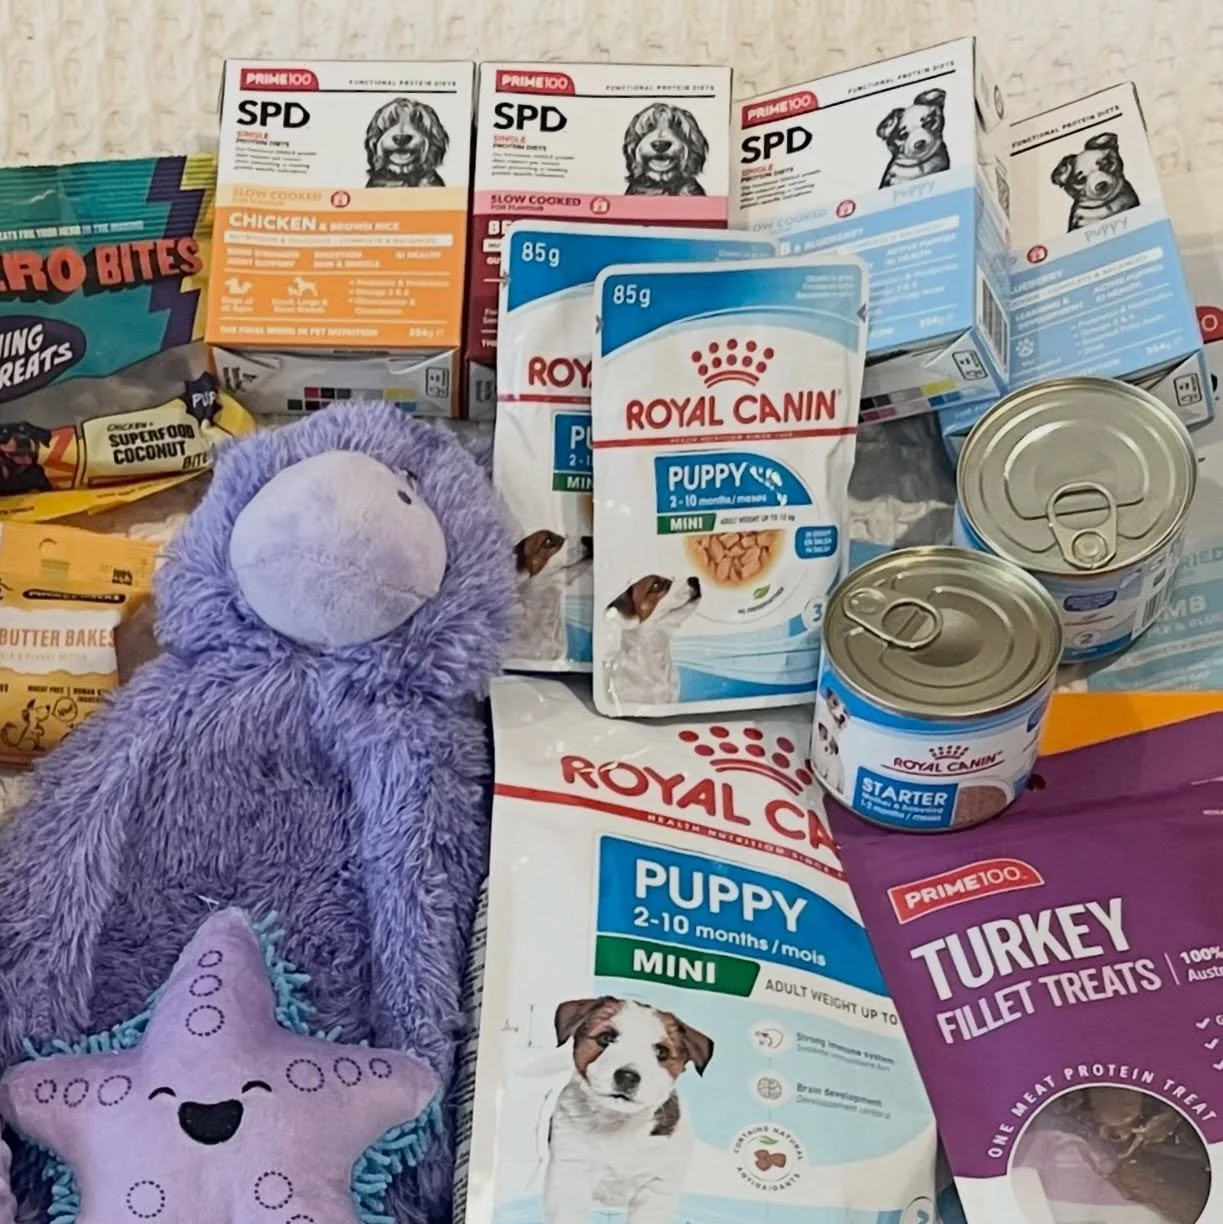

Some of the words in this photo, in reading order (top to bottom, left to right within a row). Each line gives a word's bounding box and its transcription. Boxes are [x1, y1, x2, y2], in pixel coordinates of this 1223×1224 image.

[246, 73, 312, 87] PRIME100
[501, 75, 568, 90] PRIME100
[237, 100, 311, 129] SPD
[493, 102, 567, 132] SPD
[747, 97, 812, 120] PRIME100
[740, 126, 813, 164] SPD
[491, 194, 526, 205] SLOW
[528, 195, 582, 207] COOKED
[229, 212, 317, 231] CHICKEN
[95, 237, 205, 287] BITES
[626, 395, 724, 431] ROYAL
[732, 390, 837, 425] CANIN
[108, 423, 196, 448] SUPERFOOD
[113, 440, 187, 465] COCONUT
[668, 462, 749, 492] PUPPY
[669, 518, 703, 532] MINI
[812, 603, 824, 622] 3
[893, 756, 943, 773] ROYAL
[947, 753, 997, 771] CANIN
[561, 754, 751, 826] ROYAL
[861, 777, 949, 806] STARTER
[635, 858, 809, 934] PUPPY
[905, 866, 1022, 910] PRIME100
[633, 906, 690, 936] 2-10
[695, 923, 770, 952] months
[780, 943, 828, 969] mois
[910, 897, 1131, 1001] TURKEY
[633, 948, 717, 985] MINI
[764, 979, 807, 999] ADULT
[810, 991, 858, 1015] WEIGHT
[861, 1006, 879, 1020] UP
[881, 1012, 899, 1027] TO
[936, 981, 1036, 1044] FILLET
[1039, 959, 1162, 1007] TREATS
[987, 1122, 1015, 1159] ONE
[1010, 1075, 1056, 1118] MEAT
[1063, 1063, 1155, 1085] PROTEIN
[1162, 1078, 1217, 1123] TREAT
